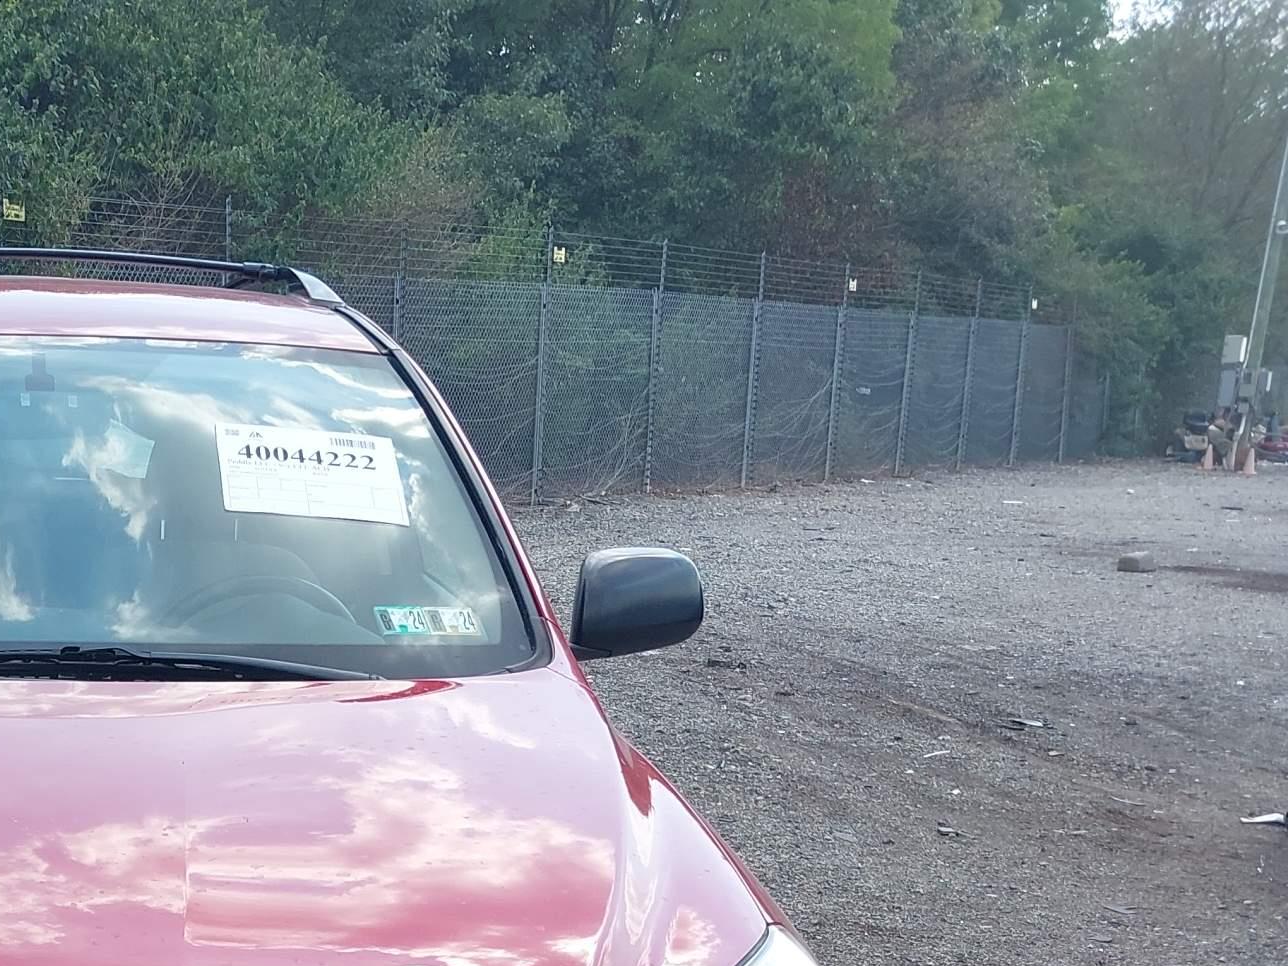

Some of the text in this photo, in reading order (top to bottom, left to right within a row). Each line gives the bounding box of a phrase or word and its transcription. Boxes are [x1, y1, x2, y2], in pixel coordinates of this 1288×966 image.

[238, 444, 376, 471] 40044222
[409, 610, 426, 630] 24
[459, 610, 477, 631] 24
